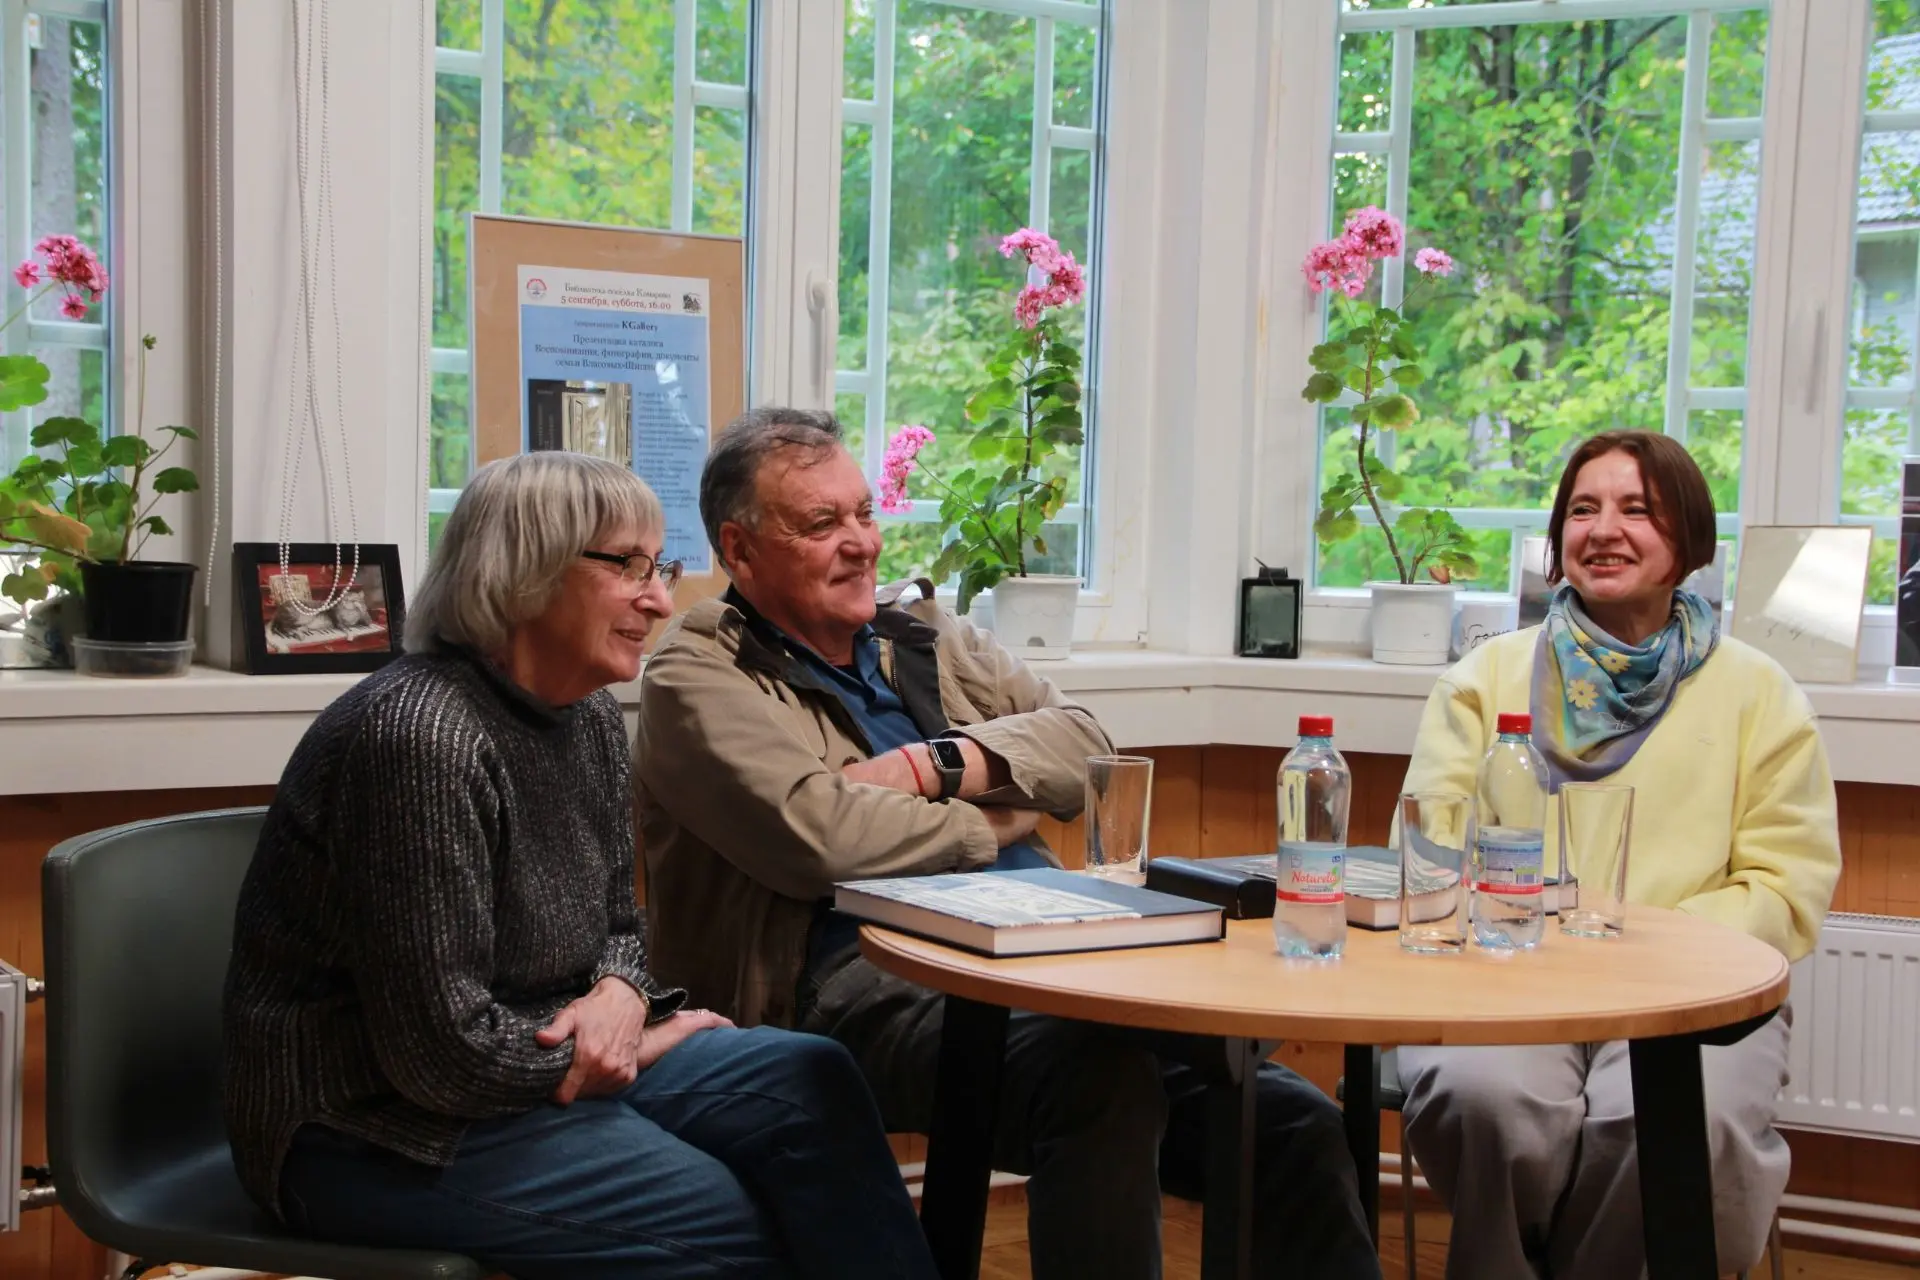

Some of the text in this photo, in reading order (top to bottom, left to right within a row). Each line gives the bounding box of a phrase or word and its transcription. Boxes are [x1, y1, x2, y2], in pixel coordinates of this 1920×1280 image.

[560, 295, 671, 310] 5 сентября, суббота, 16.00
[621, 320, 659, 332] KGallery
[572, 334, 627, 346] Презентация
